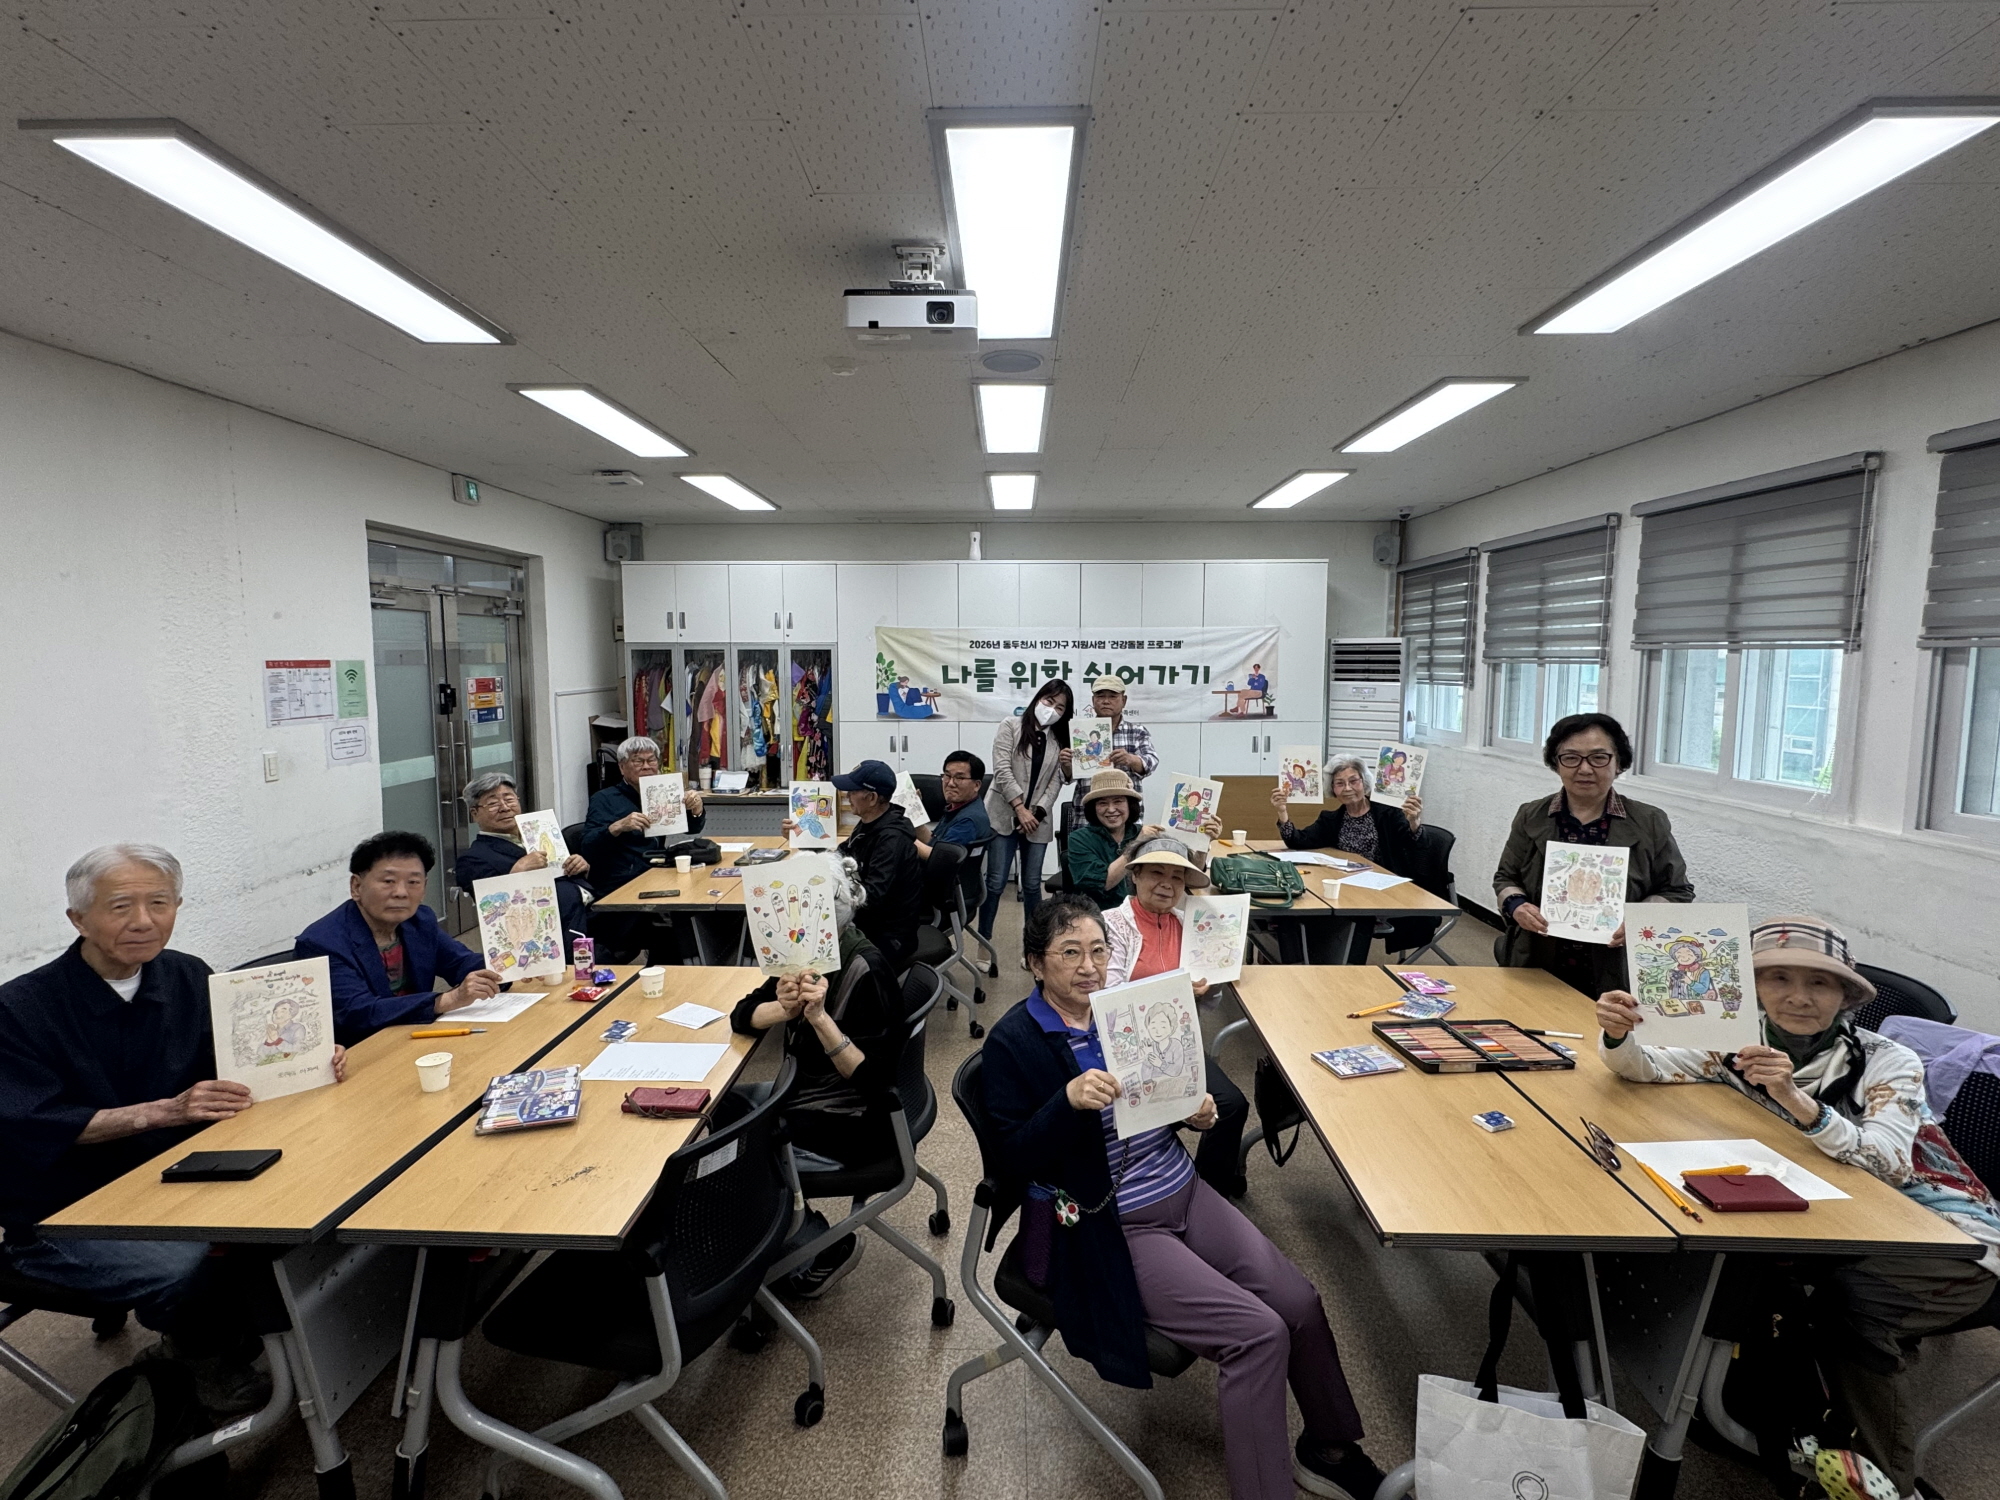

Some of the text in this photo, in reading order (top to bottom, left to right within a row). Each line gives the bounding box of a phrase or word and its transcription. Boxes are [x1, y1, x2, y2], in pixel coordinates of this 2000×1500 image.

[969, 640, 1000, 649] 2026년
[1003, 640, 1037, 649] 동두천시
[1039, 640, 1069, 649] 1인가구
[1071, 640, 1106, 649] 지원사업
[1147, 640, 1184, 649] 프로그램'
[942, 658, 998, 693] 나를
